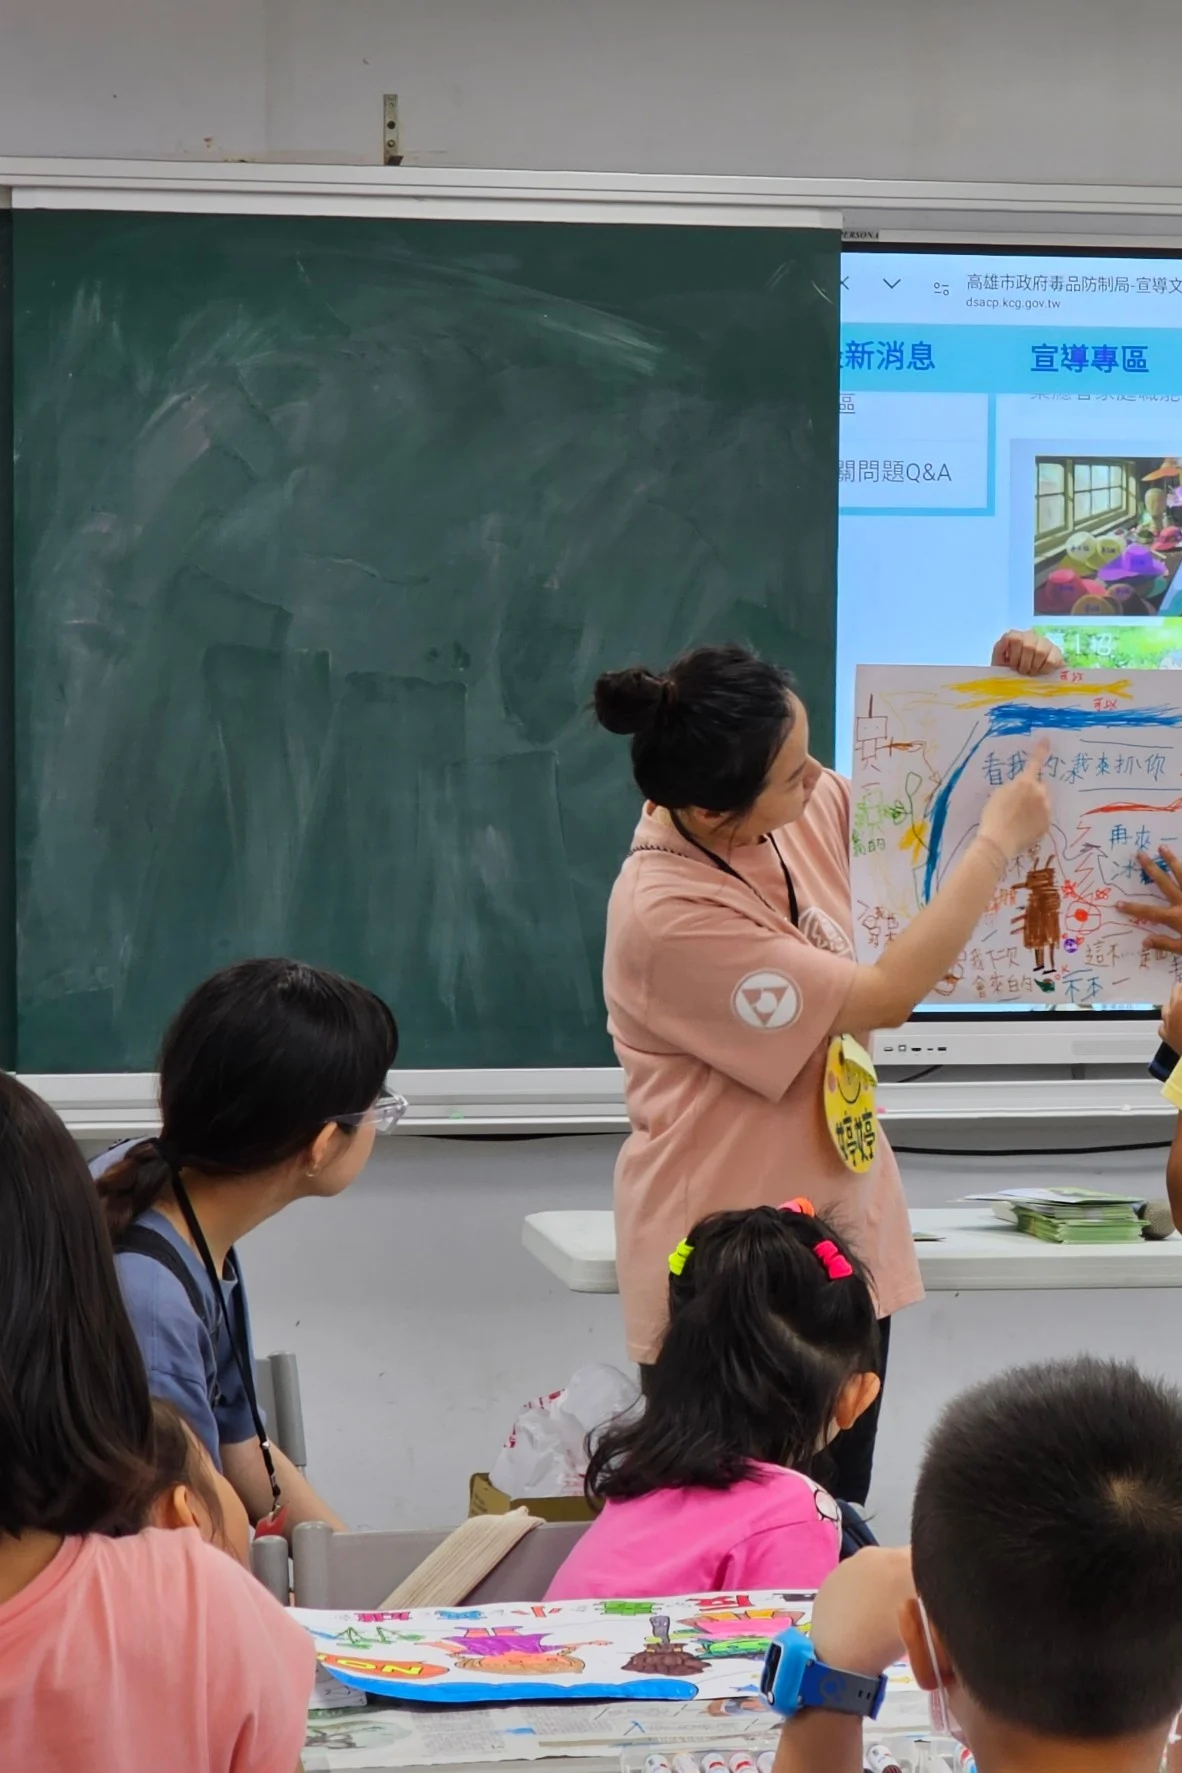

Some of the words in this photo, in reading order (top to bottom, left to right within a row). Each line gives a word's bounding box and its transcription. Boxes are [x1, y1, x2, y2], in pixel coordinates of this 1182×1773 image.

[966, 297, 1061, 310] dsacp.kcg.gov.tw
[839, 340, 936, 372] 新消息
[1030, 344, 1150, 374] 宣導專區
